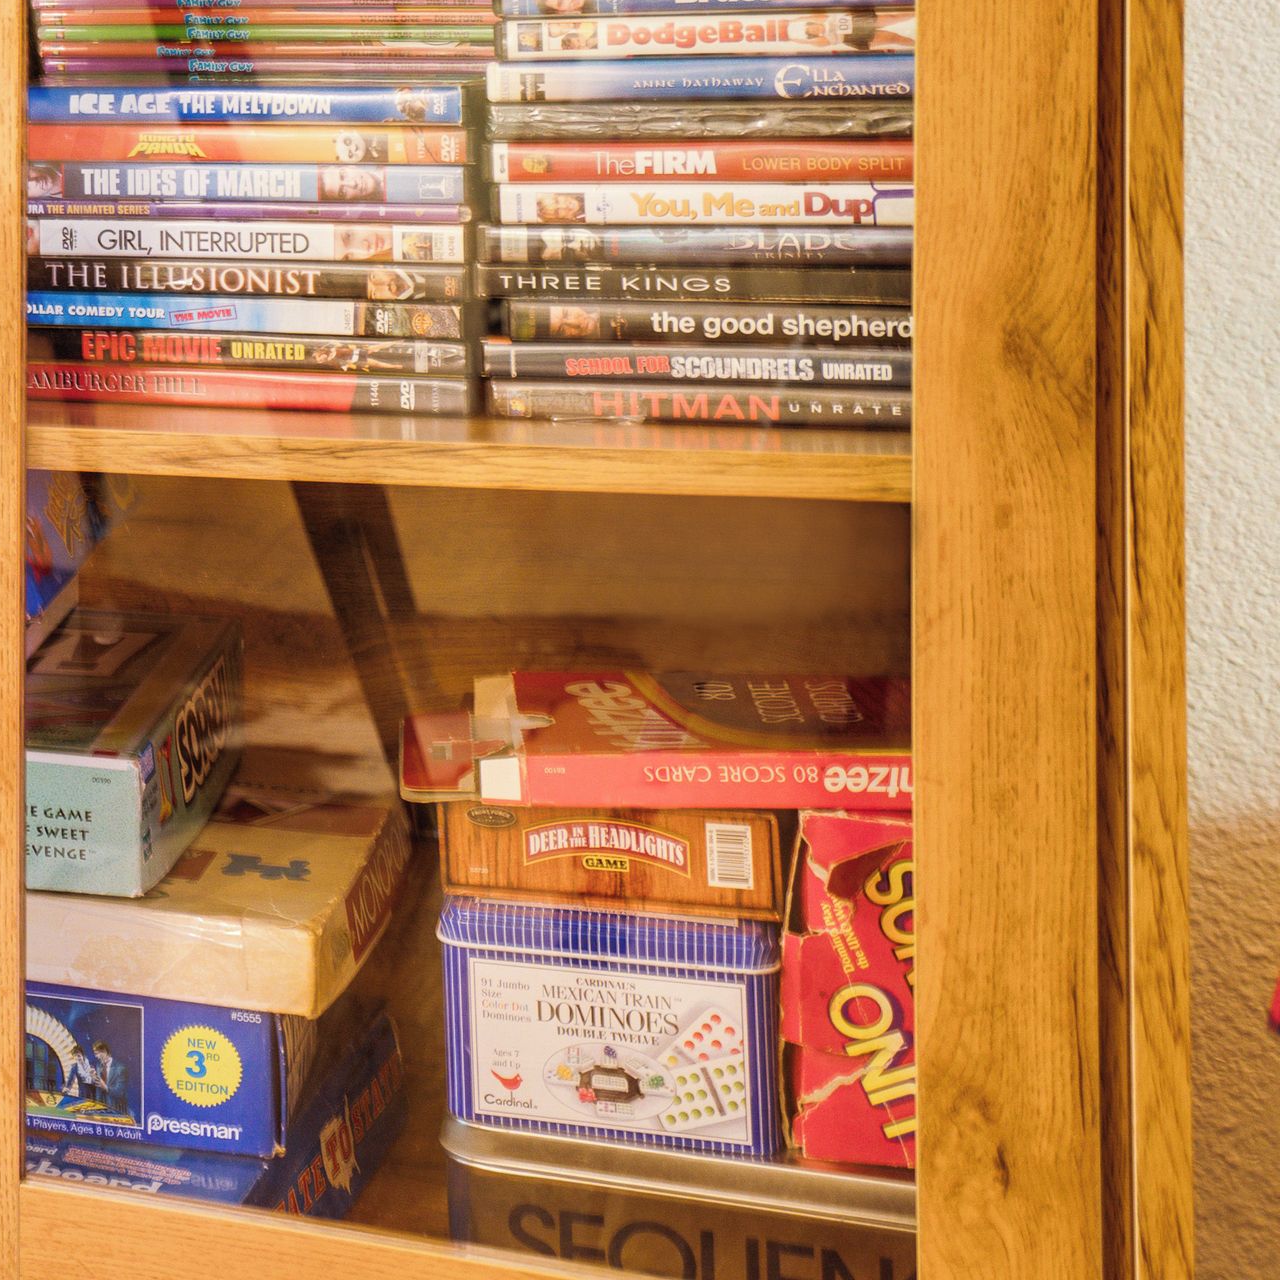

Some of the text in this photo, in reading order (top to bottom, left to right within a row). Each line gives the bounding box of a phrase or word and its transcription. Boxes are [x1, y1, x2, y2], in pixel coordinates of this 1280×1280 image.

[69, 93, 332, 116] ICE AGE THE MELTDOWN
[81, 168, 302, 198] THE IDES OF MARCH
[46, 204, 151, 216] THE ANIMATED SERIES
[751, 250, 828, 261] TRINITY
[45, 264, 321, 295] THE ILLUSIONIST
[498, 274, 733, 293] THREE KINGS
[650, 310, 914, 341] the good shepherd
[81, 332, 306, 363] EPIC MOVIE UNRATED
[565, 355, 894, 383] SCHOOL FOR SCOUNDRELS UNRATED
[591, 391, 903, 421] HITMAN UNRATE
[642, 764, 819, 785] 80 SCORE CARDS
[528, 824, 686, 867] DEER IN HEADLIGHTS
[584, 857, 629, 871] GAME
[480, 977, 531, 992] 91 Jumbo
[481, 988, 503, 1000] Size
[536, 999, 680, 1037] DOMINOES
[186, 1036, 218, 1051] NEW
[175, 1079, 231, 1096] EDITION
